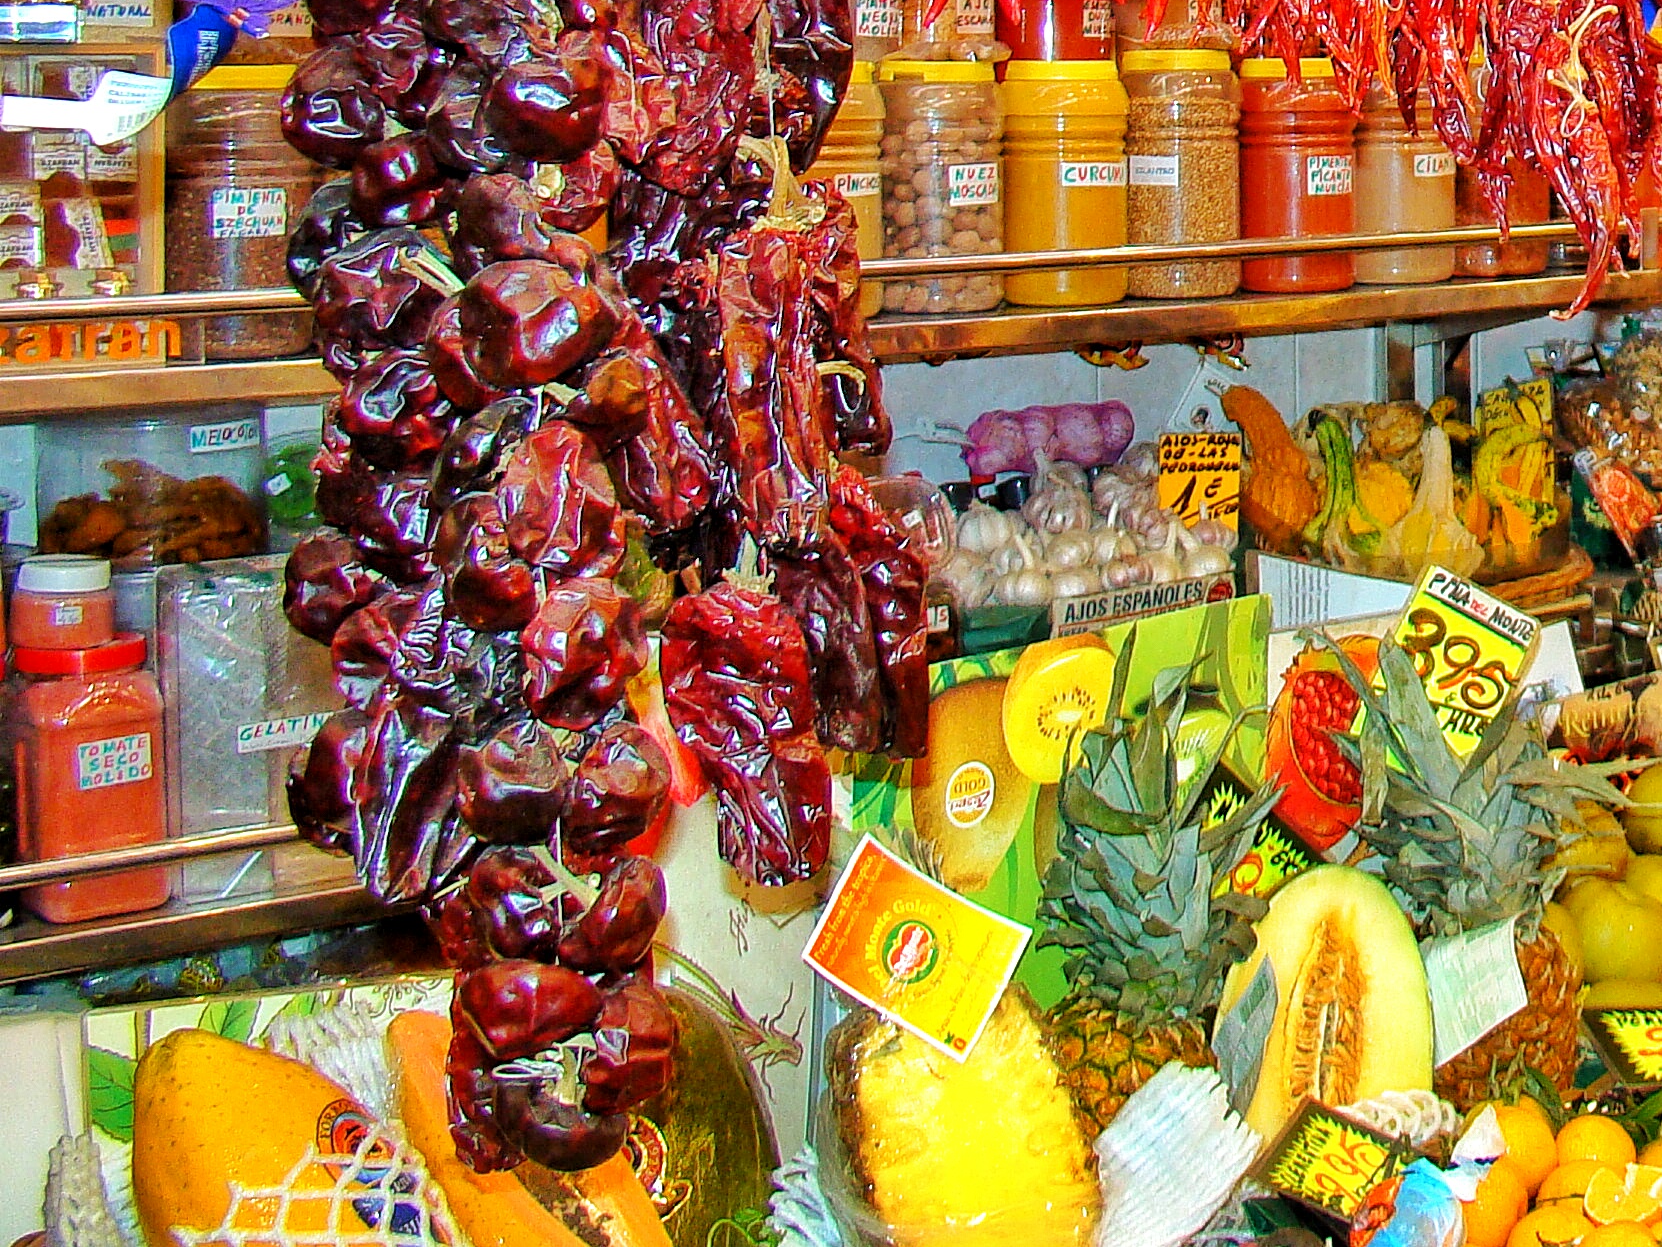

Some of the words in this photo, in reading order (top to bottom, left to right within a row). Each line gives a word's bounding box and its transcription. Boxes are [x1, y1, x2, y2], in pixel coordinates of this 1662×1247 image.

[955, 166, 996, 182] NUEZ
[212, 187, 283, 204] PIMIENTA
[1065, 597, 1108, 623] AJOS
[1112, 581, 1204, 615] ESPAÑOLES
[1428, 572, 1472, 607] PIÑA
[1469, 598, 1488, 617] DEL
[79, 736, 147, 759] TOMATE
[88, 752, 140, 772] SECO
[81, 763, 151, 788] MOLIDO
[864, 910, 893, 962] Monte
[893, 899, 932, 917] Gold
